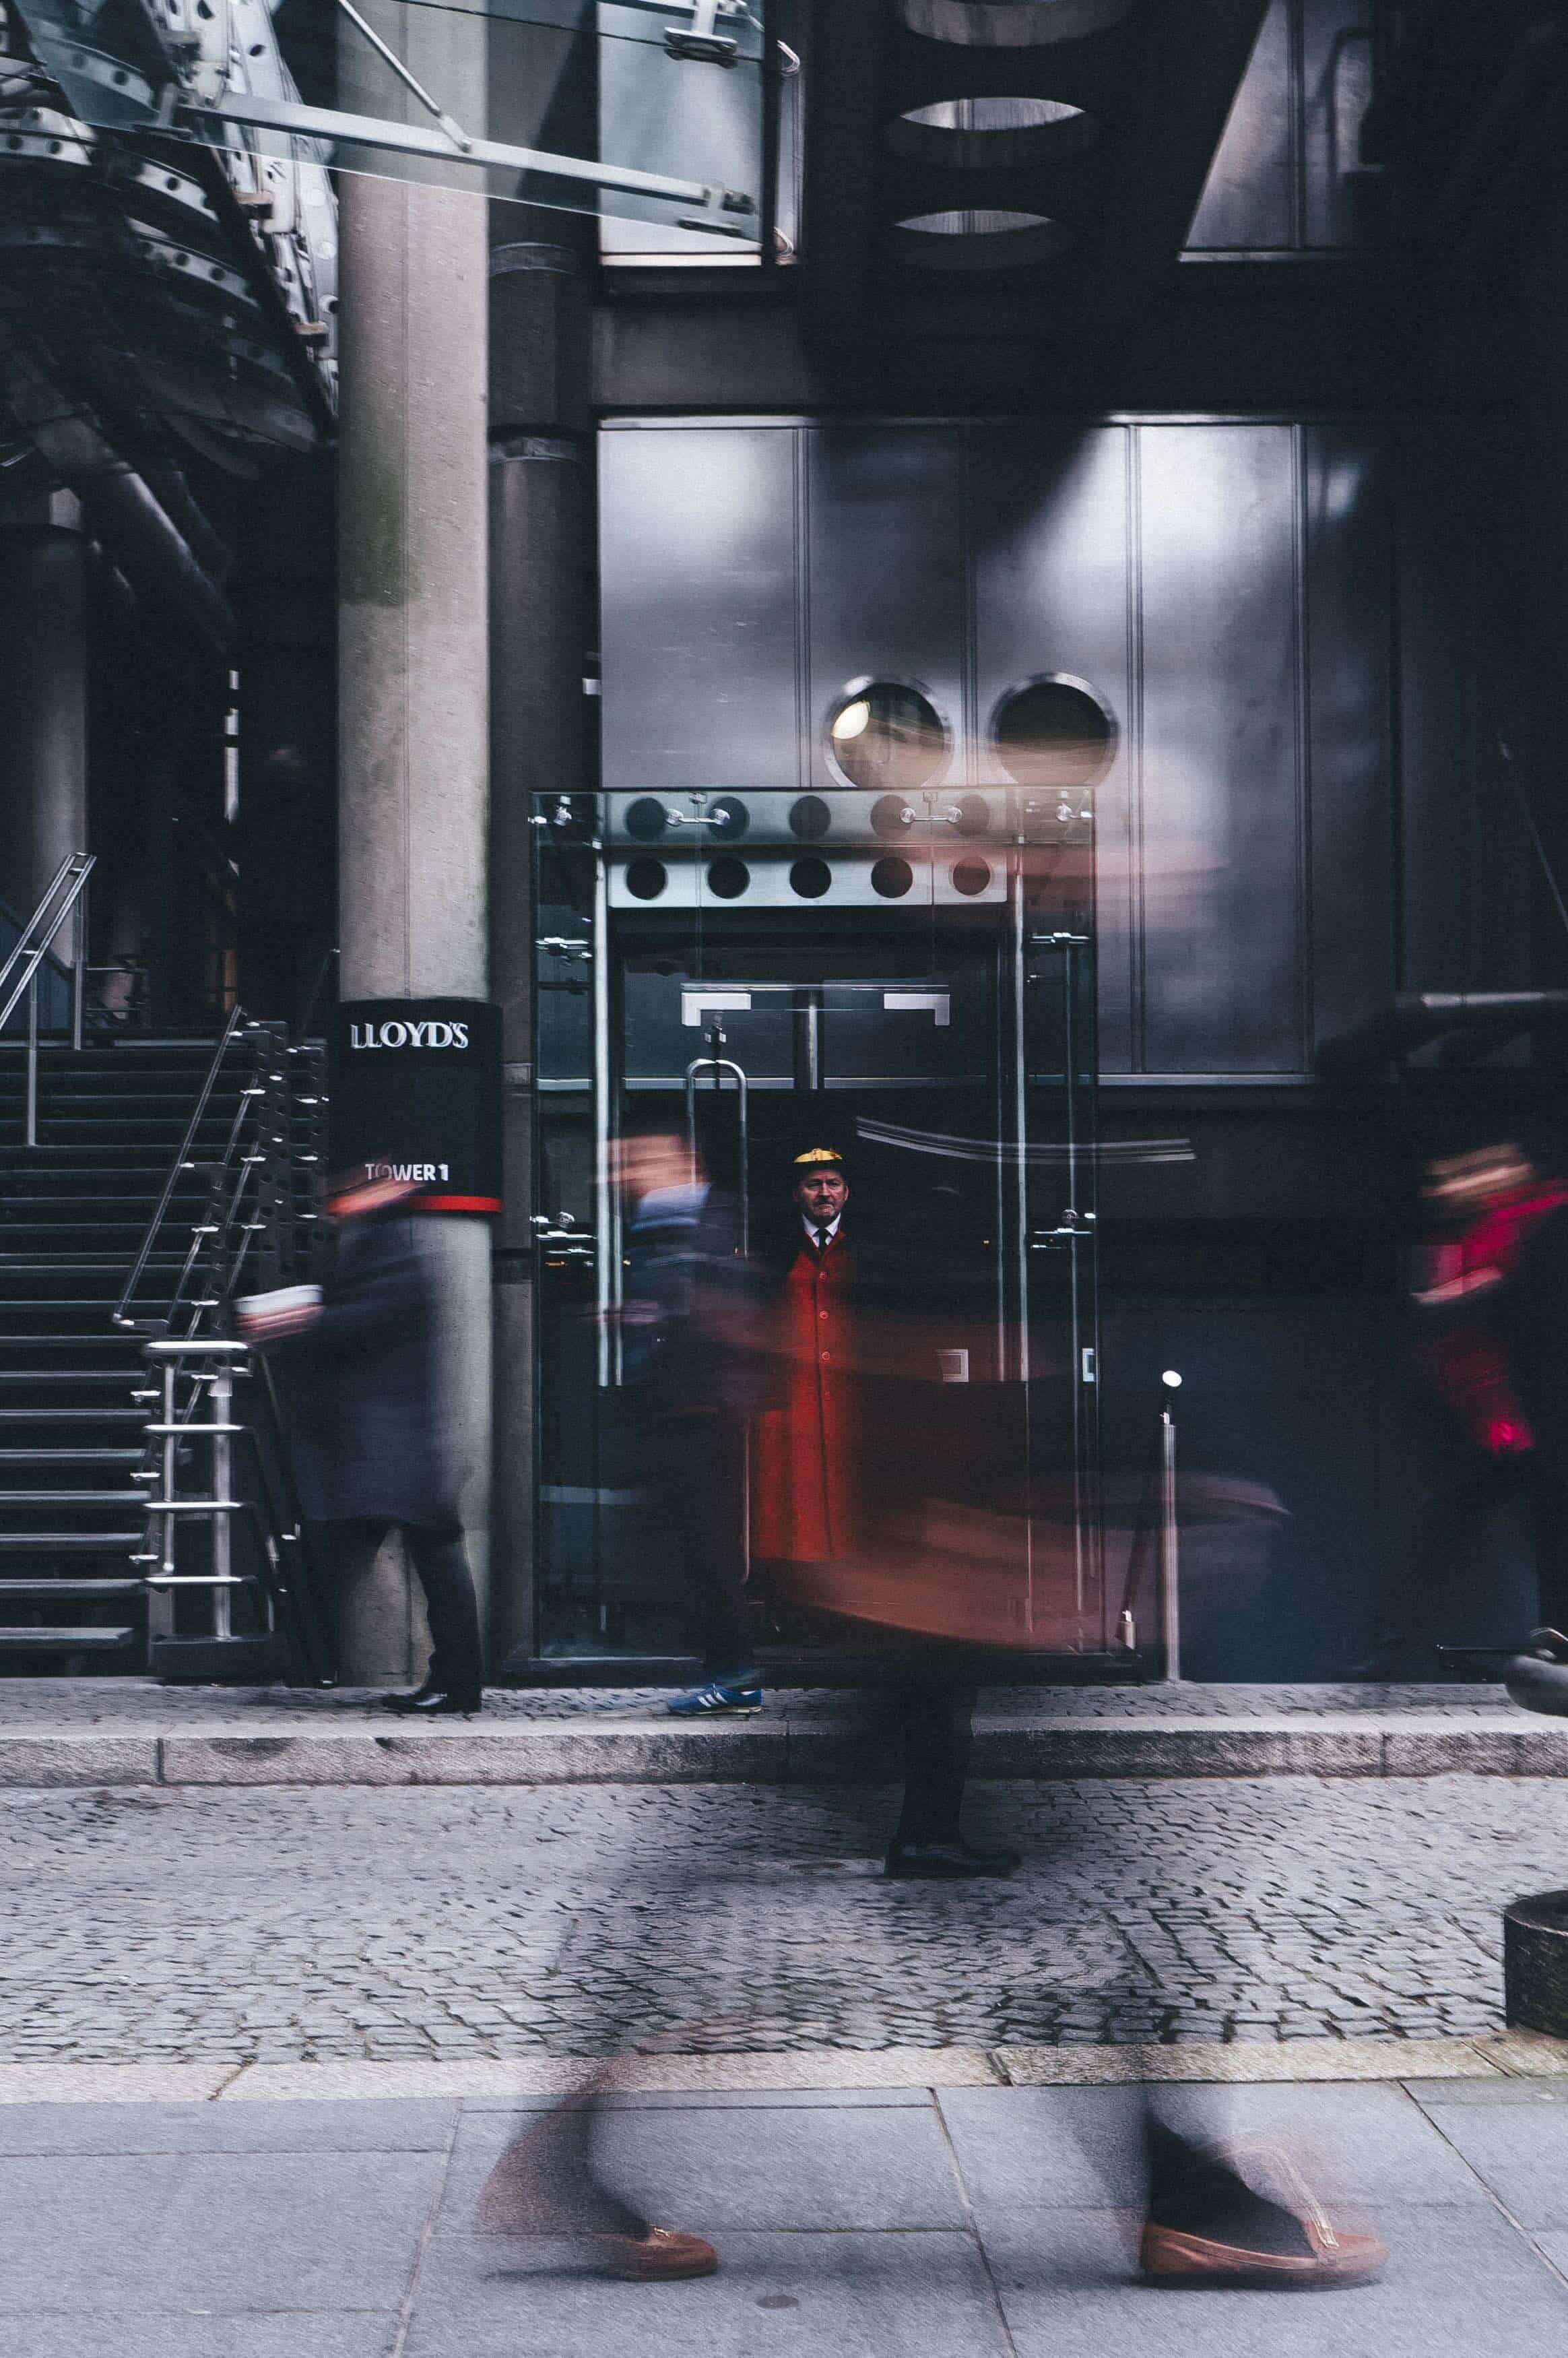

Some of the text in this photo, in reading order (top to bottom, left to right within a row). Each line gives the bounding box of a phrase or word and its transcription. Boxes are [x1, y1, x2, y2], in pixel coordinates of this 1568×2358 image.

[350, 1021, 469, 1049] LLOYD'S
[364, 1164, 449, 1181] TOWER 1
